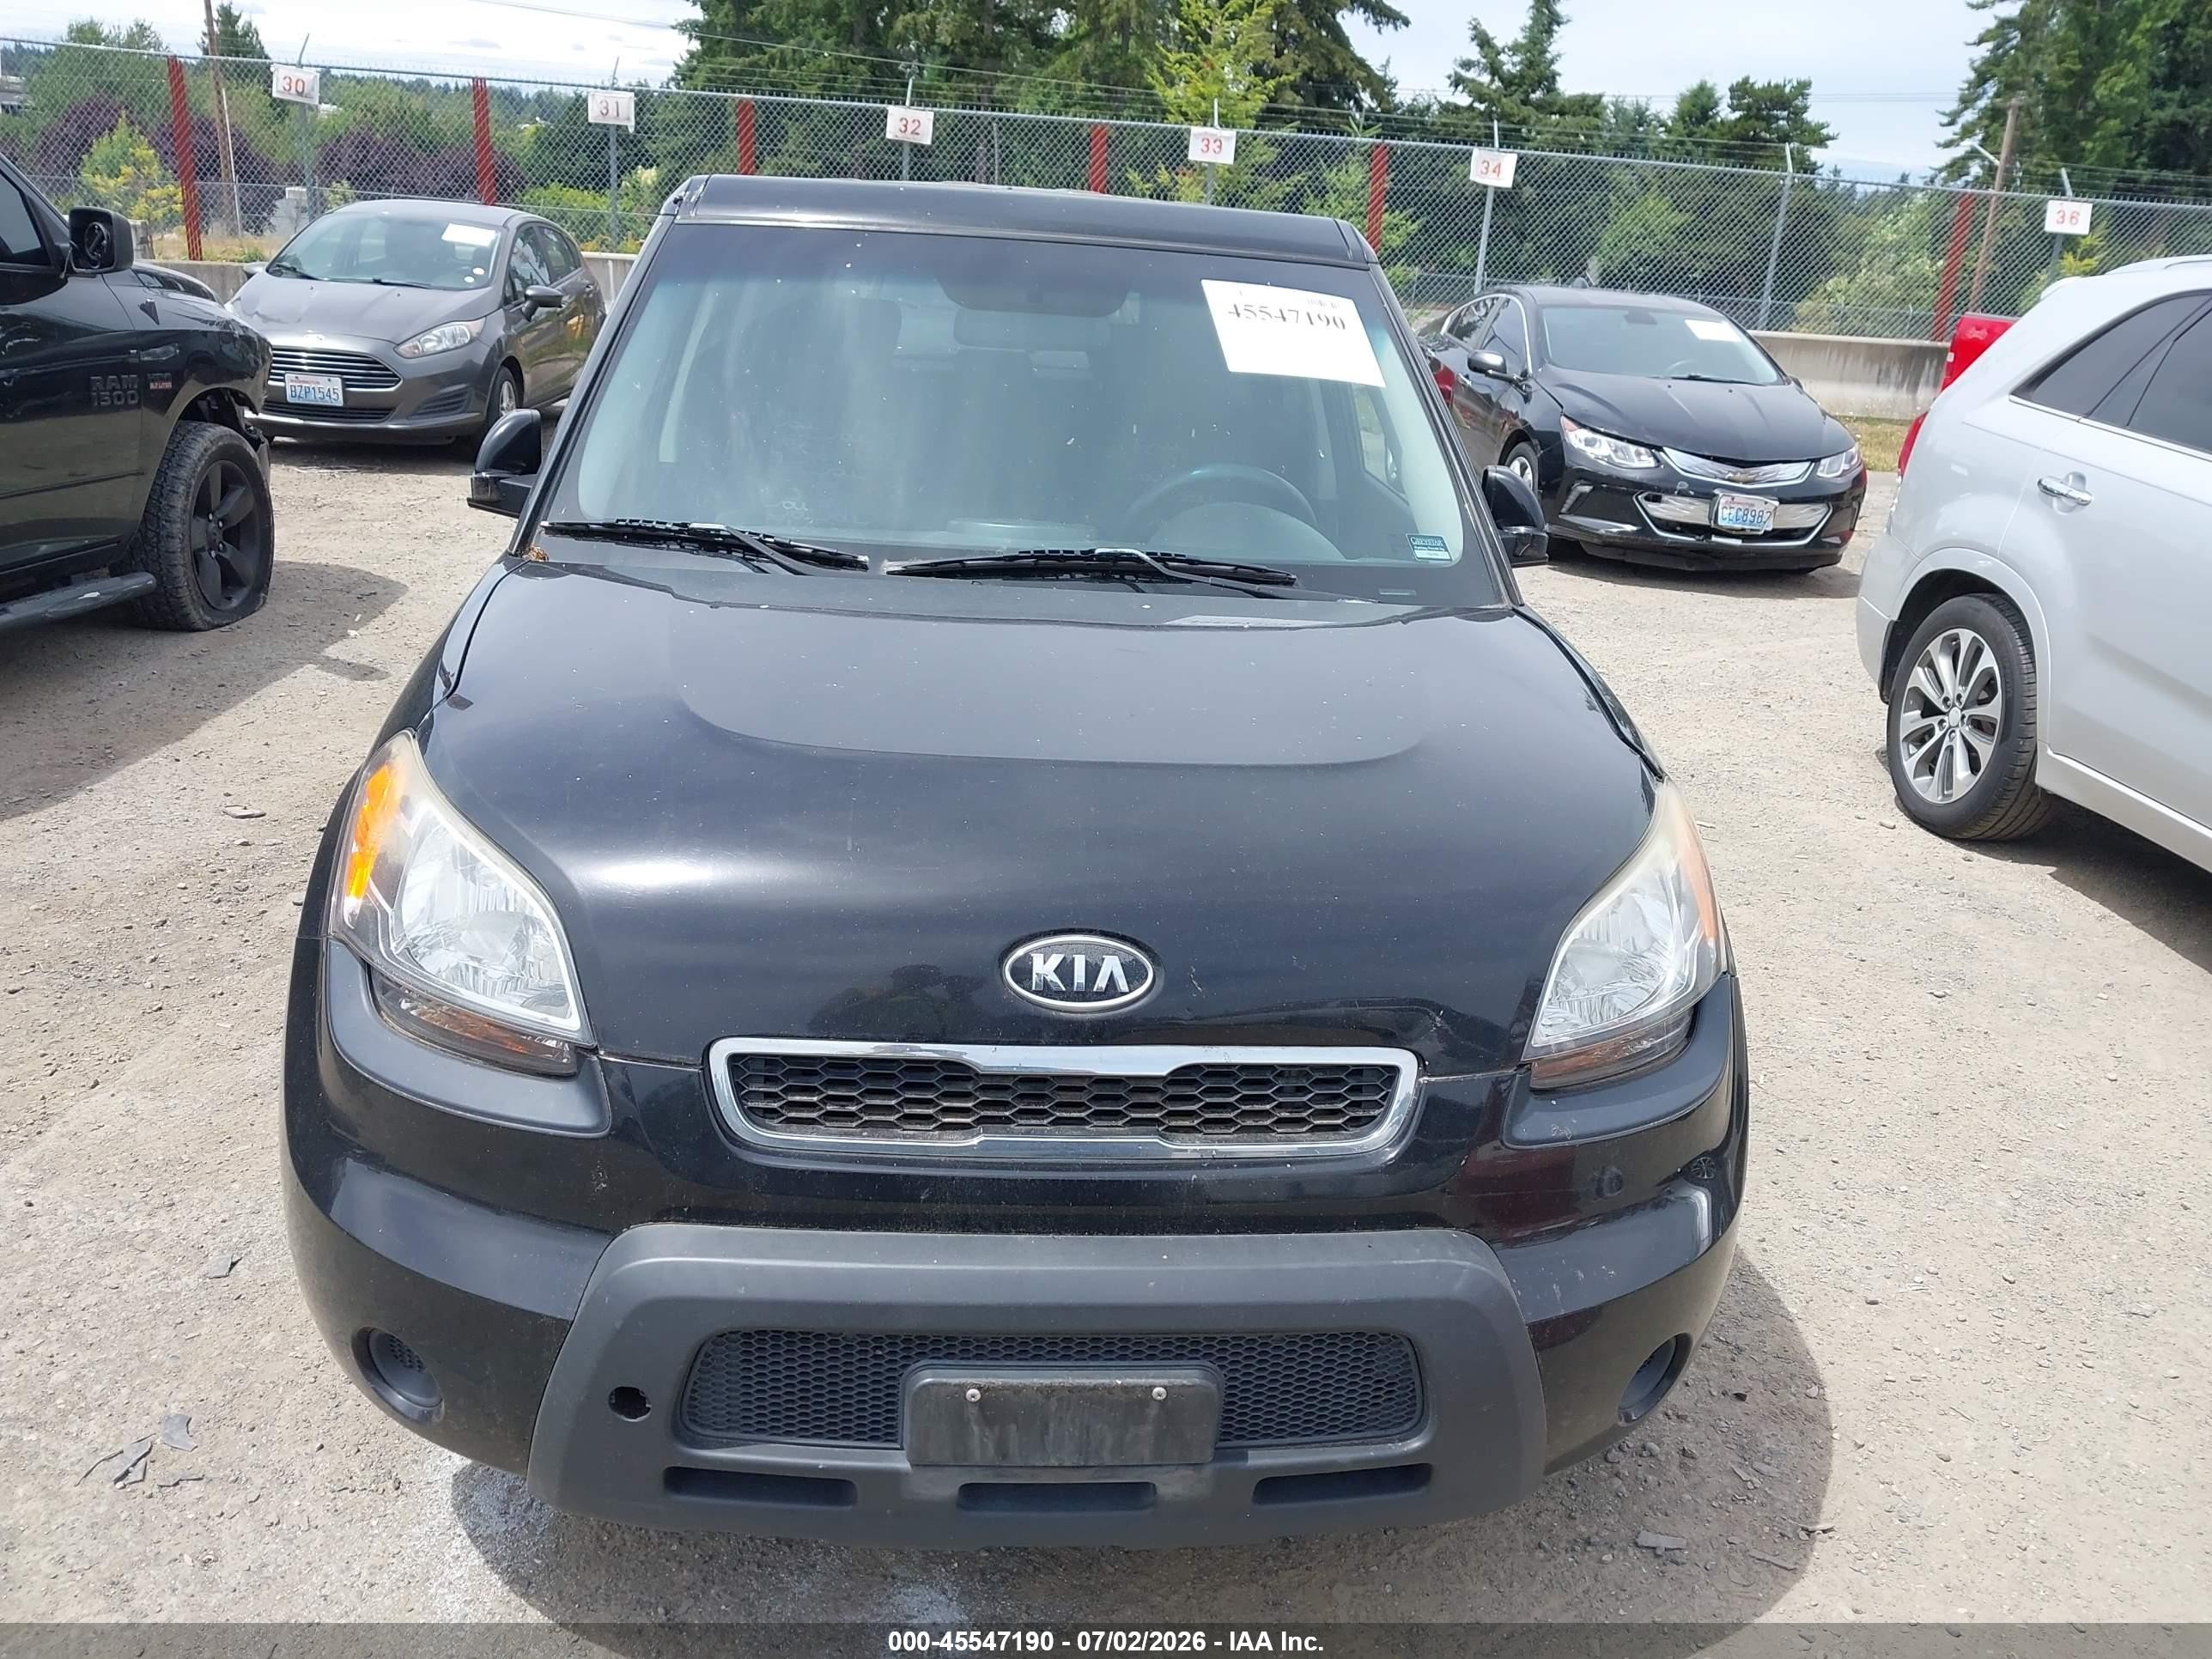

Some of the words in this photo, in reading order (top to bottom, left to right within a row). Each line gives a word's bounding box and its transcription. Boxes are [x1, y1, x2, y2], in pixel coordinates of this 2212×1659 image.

[283, 76, 305, 95] 30
[599, 99, 619, 118] 31
[899, 117, 921, 136] 32
[1200, 137, 1223, 155] 33
[1480, 160, 1502, 178] 34
[2056, 210, 2081, 226] 36
[1228, 303, 1346, 331] 45547190
[89, 374, 138, 391] RAM
[90, 390, 140, 406] 1500
[289, 384, 340, 402] BZP1545
[1030, 953, 1129, 993] KIA
